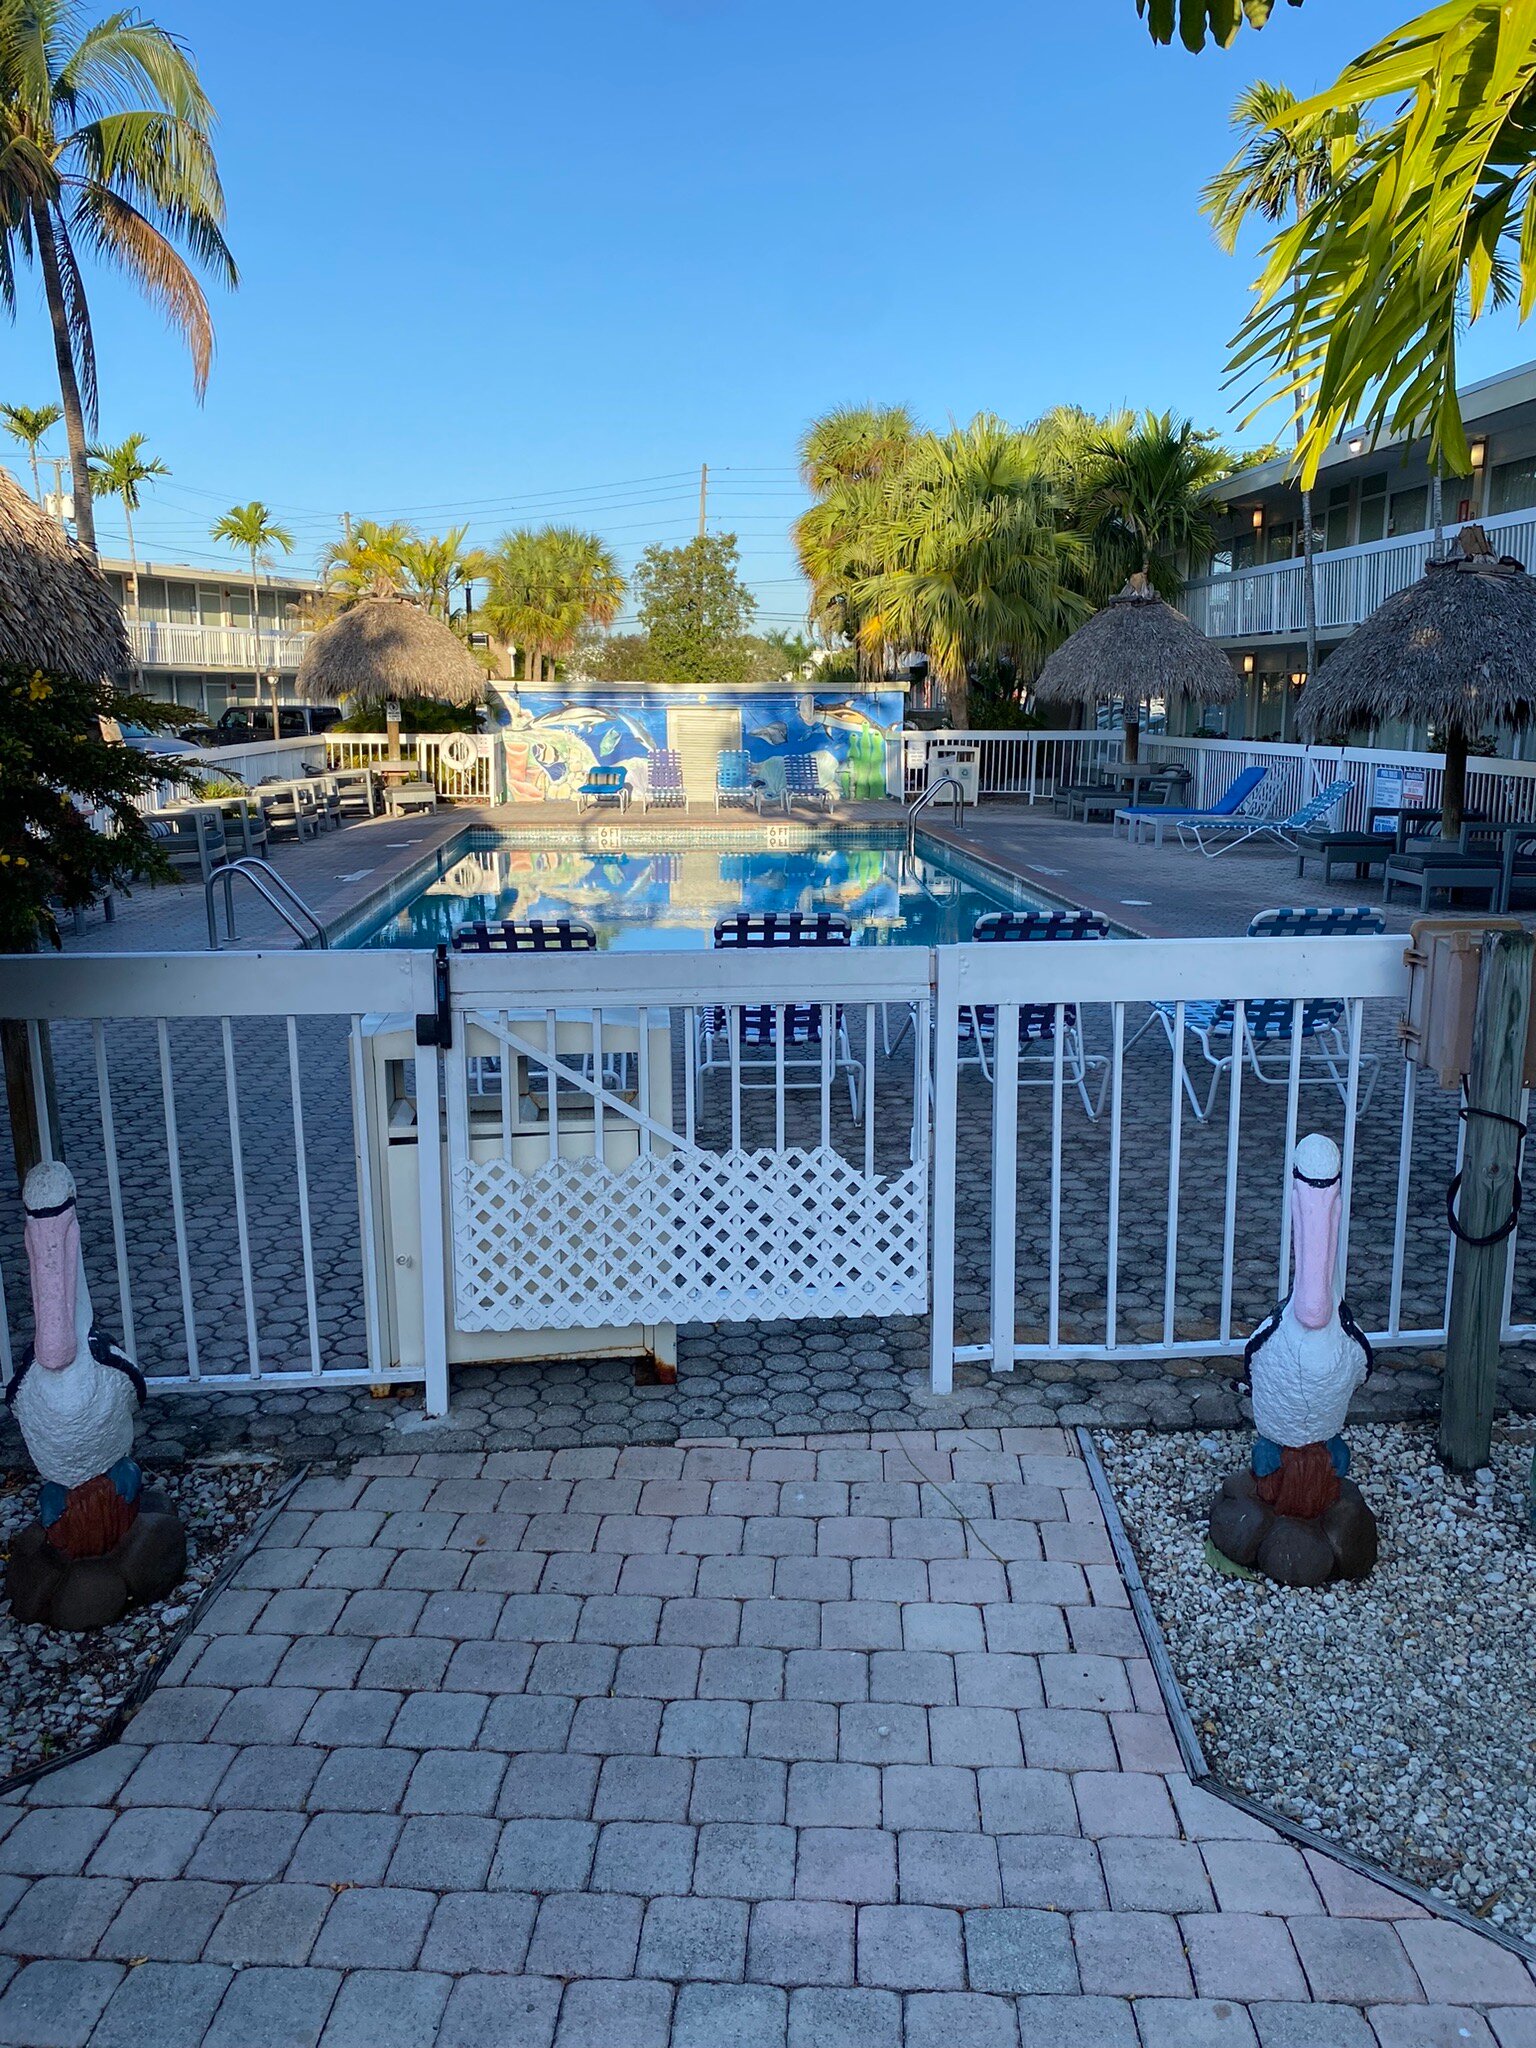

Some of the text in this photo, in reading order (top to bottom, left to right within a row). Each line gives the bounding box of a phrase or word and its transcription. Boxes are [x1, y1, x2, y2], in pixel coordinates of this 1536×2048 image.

[600, 827, 620, 838] 6 FT
[769, 826, 788, 837] 6 FT
